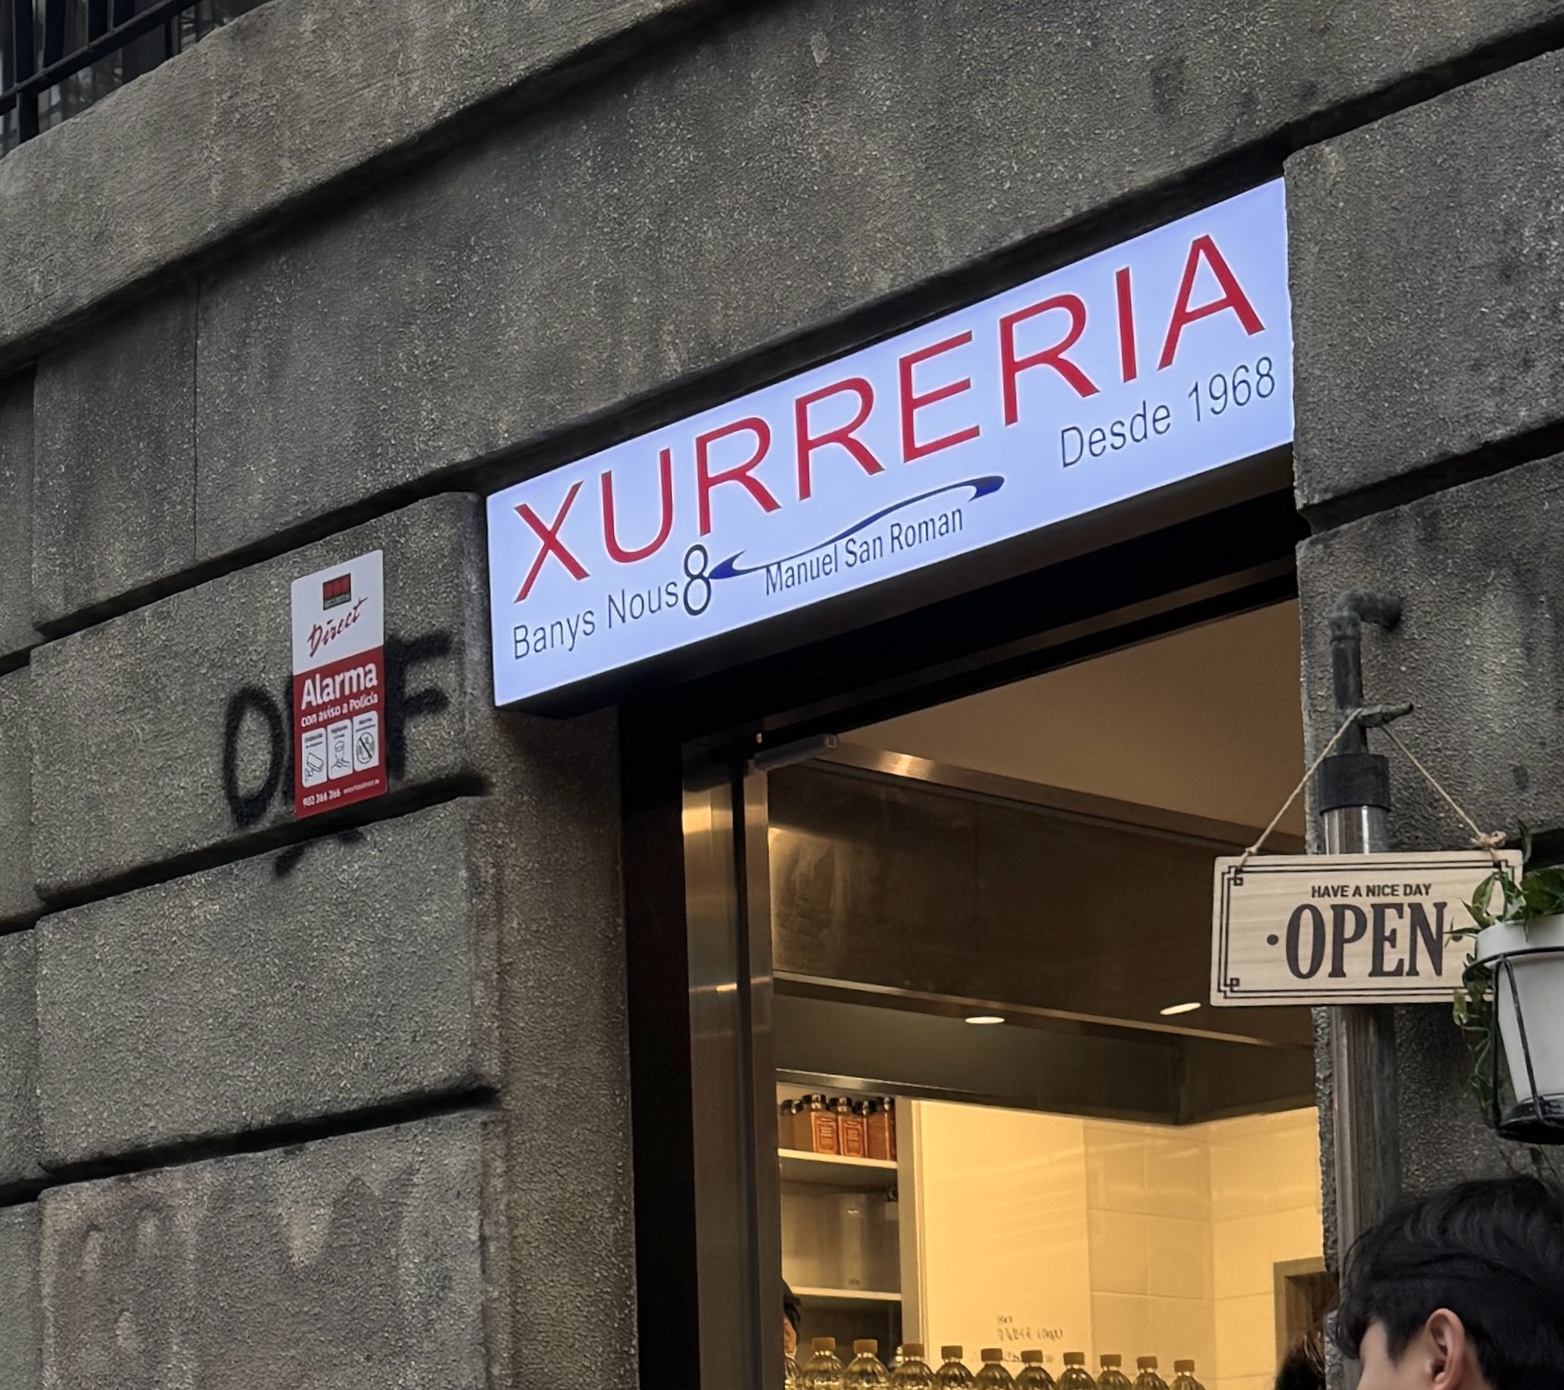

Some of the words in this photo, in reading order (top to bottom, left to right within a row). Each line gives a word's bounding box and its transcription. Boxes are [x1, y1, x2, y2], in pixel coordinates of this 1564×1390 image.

[513, 234, 1265, 603] XURRERIA
[1060, 400, 1172, 469] Desde
[1187, 356, 1276, 423] 1968
[765, 552, 839, 596] Manuel
[844, 534, 884, 570] San
[890, 508, 963, 554] Roman
[307, 597, 368, 657] Direct
[513, 606, 596, 660] Banys
[608, 582, 679, 629] Nous
[682, 544, 713, 616] 8
[301, 663, 379, 710] Alarma
[301, 713, 318, 728] con
[318, 705, 341, 722] aviso
[342, 703, 349, 714] a
[349, 691, 378, 712] Policía
[1311, 885, 1350, 898] HAVE
[1352, 885, 1363, 897] A
[1366, 884, 1400, 897] NICE
[1403, 883, 1432, 897] DAY
[1286, 901, 1448, 980] OPEN
